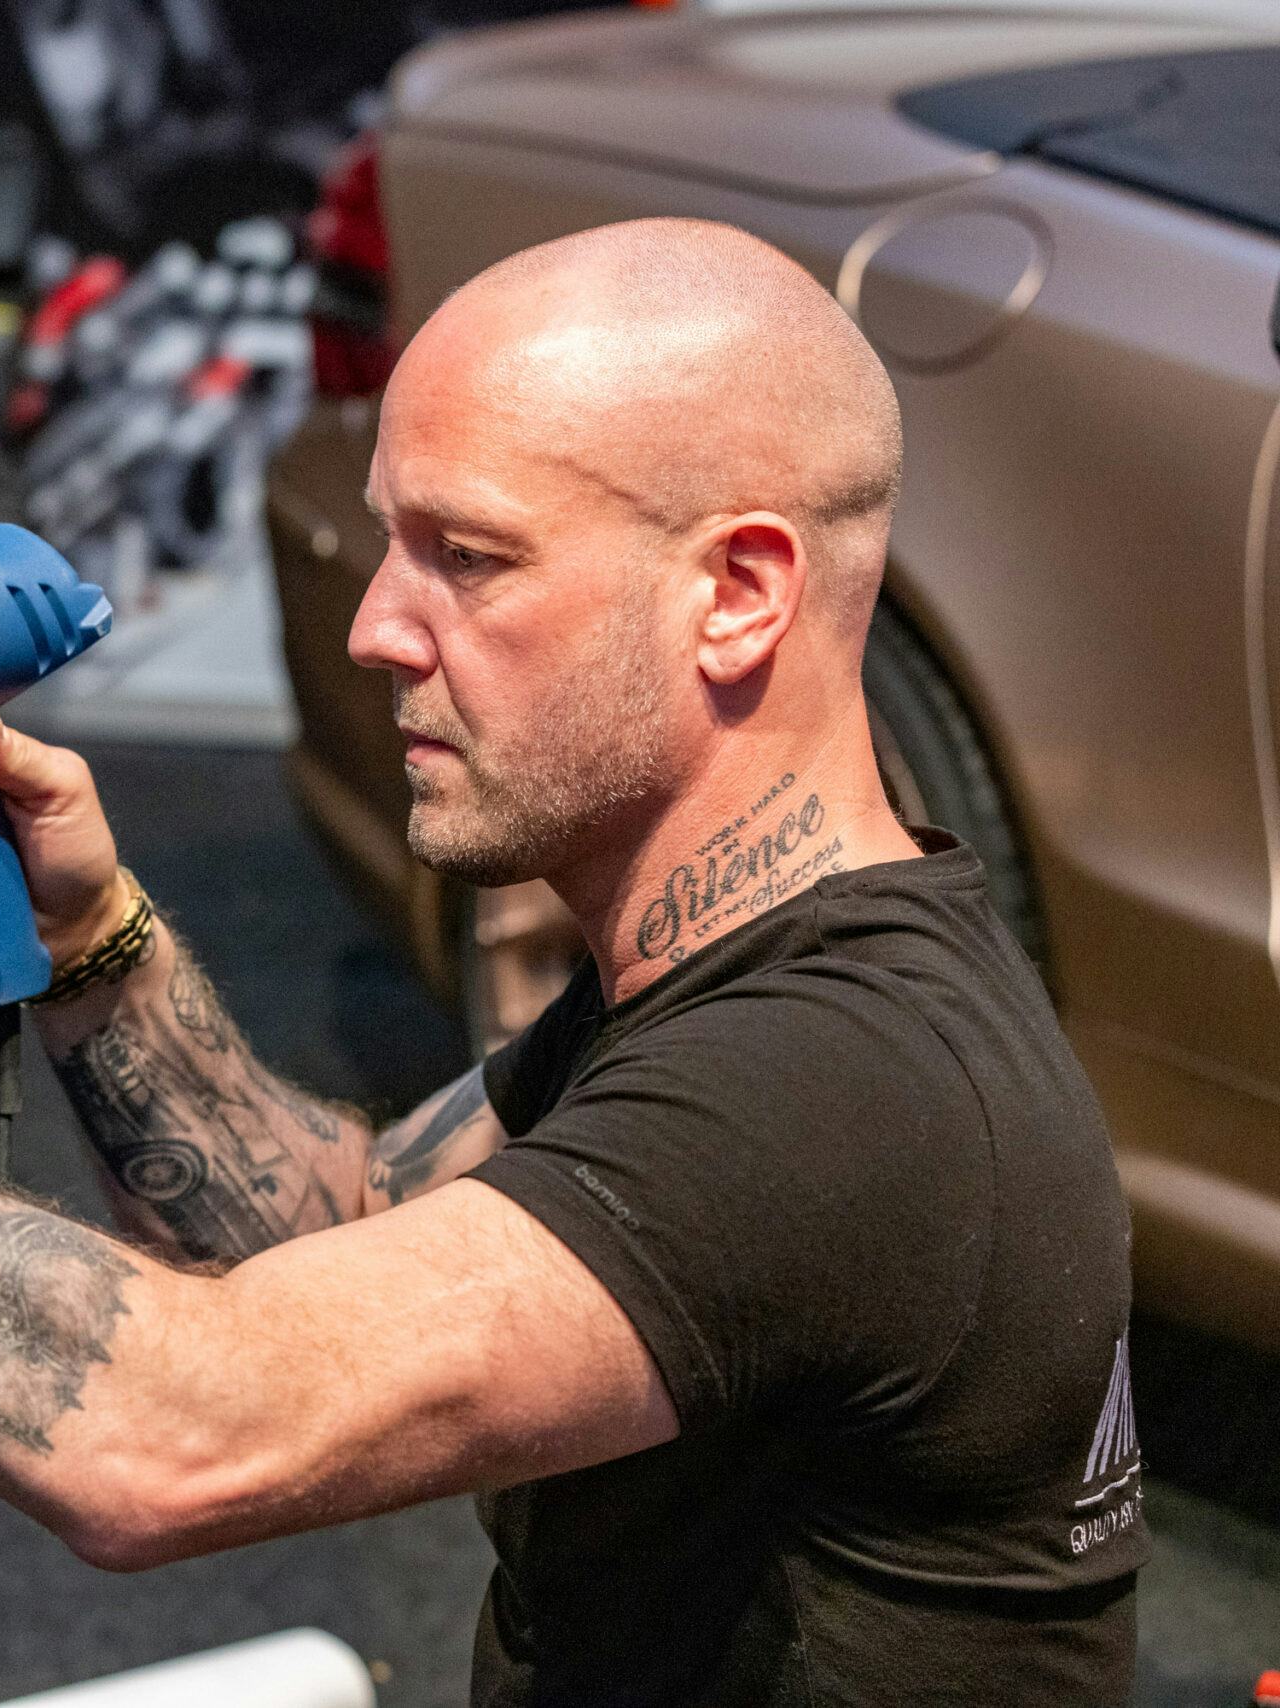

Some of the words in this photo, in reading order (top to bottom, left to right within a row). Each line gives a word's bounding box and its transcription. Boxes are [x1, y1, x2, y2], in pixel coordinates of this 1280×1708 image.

[695, 815, 748, 855] WORK
[751, 772, 796, 815] HARD
[723, 838, 740, 855] IN
[637, 793, 825, 960] Silence
[694, 914, 720, 937] LET
[750, 836, 843, 916] Success
[575, 1164, 640, 1230] bamigo
[1070, 1510, 1118, 1554] QUALITY
